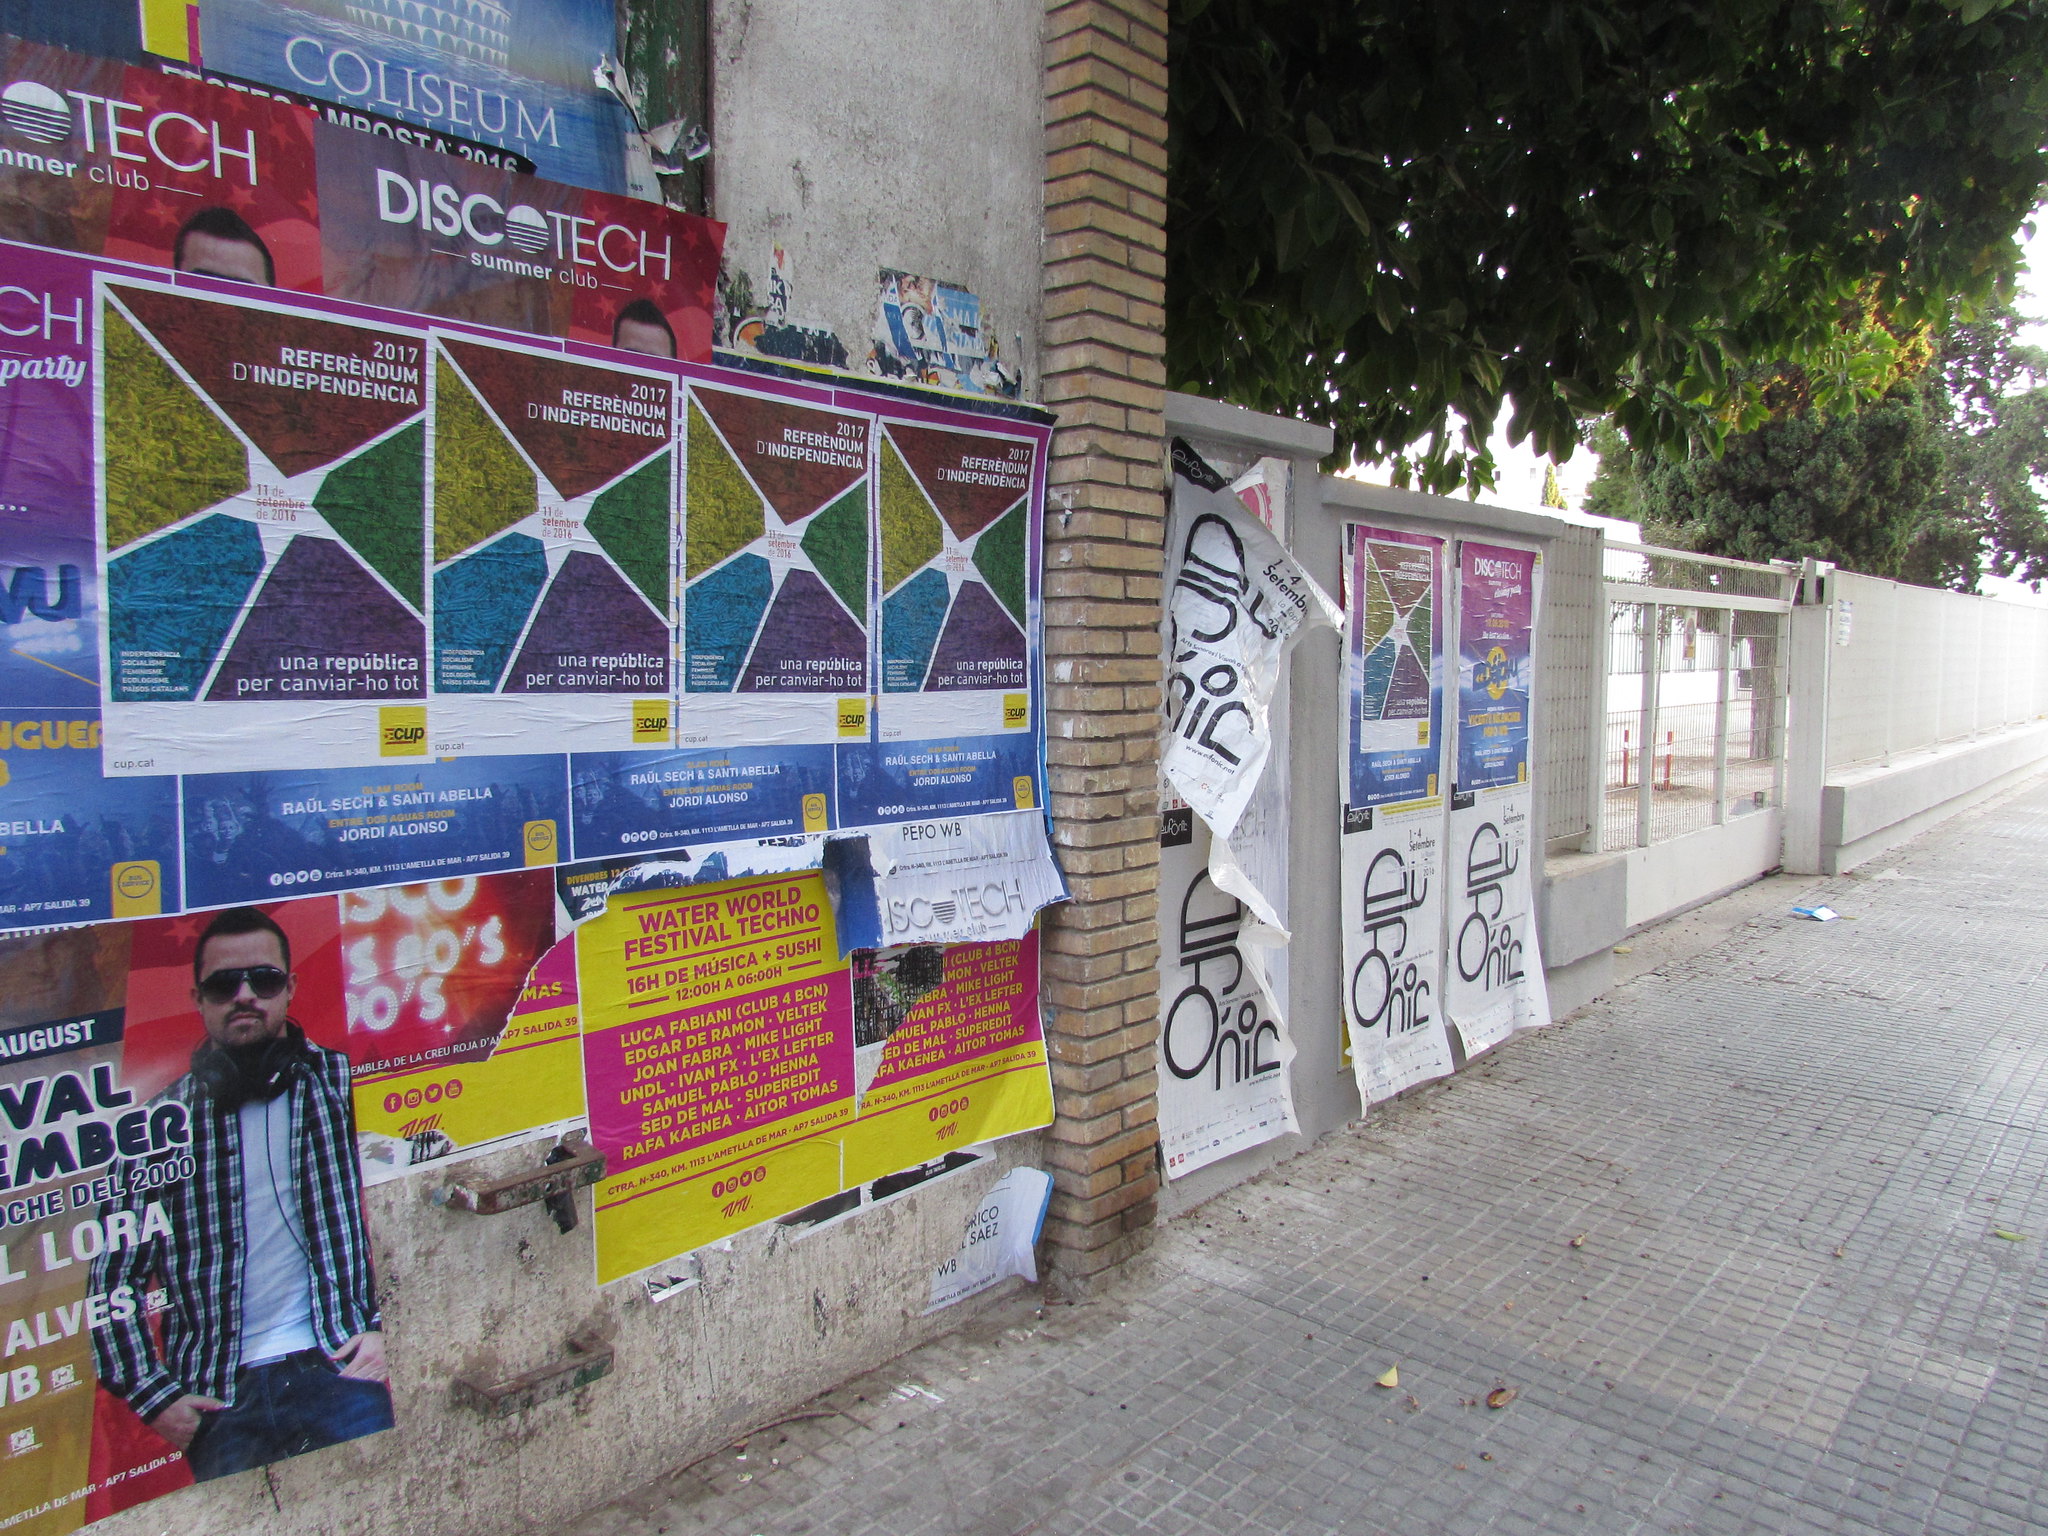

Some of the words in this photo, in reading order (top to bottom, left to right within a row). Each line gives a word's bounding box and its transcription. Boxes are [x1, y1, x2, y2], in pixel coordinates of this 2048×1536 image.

[286, 37, 561, 148] COLISEUM
[89, 164, 150, 191] club
[471, 251, 552, 280] summer
[559, 268, 598, 289] club
[373, 341, 419, 364] 2017
[281, 347, 419, 385] REFERÈNDUM
[233, 362, 419, 405] D'INDEPENDÈNCIA
[631, 383, 666, 403] 2017
[563, 390, 666, 421] REFERÈNDUM
[528, 402, 666, 439] D'INDEPENDÈNCIA
[837, 422, 865, 439] 2017
[783, 428, 864, 455] REFERÈNDUM
[757, 441, 864, 470] D'INDEPENDÈNCIA
[961, 456, 1028, 475] REFERÈNDUM
[1008, 448, 1030, 462] 2017
[256, 497, 305, 509] setembre
[542, 517, 578, 528] setembre
[280, 657, 318, 671] una
[325, 653, 419, 675] república
[558, 656, 587, 668] una
[592, 652, 664, 672] república
[780, 659, 802, 670] una
[806, 656, 862, 674] república
[957, 659, 974, 670] una
[977, 658, 1023, 674] república
[237, 676, 271, 696] per
[280, 674, 390, 692] canviar-ho
[395, 674, 419, 691] tot
[526, 673, 552, 689] per
[558, 671, 640, 687] canviar-ho
[646, 671, 664, 686] tot
[756, 675, 777, 689] per
[781, 672, 843, 686] canviar-ho
[847, 673, 862, 687] tot
[938, 675, 956, 687] per
[957, 673, 1008, 686] canviar-ho
[434, 742, 464, 752] cup.cat
[685, 734, 708, 744] cup.cat
[113, 758, 155, 770] cup.cat
[665, 770, 694, 782] SECH
[708, 767, 738, 779] SANTI
[741, 765, 780, 776] ABELLA
[913, 776, 939, 786] JORDI
[333, 795, 374, 811] SECH
[392, 791, 435, 806] SANTI
[439, 787, 493, 802] ABELLA
[670, 797, 702, 808] JORDI
[706, 792, 748, 805] ALONSO
[339, 826, 385, 842] JORDI
[389, 821, 448, 837] ALONSO
[902, 824, 936, 841] PEPO
[940, 822, 962, 837] WB
[567, 870, 608, 885] DIVENDRES
[638, 902, 720, 934] WATER
[726, 886, 802, 916] WORLD
[624, 923, 732, 960] FESTIVAL
[737, 904, 820, 930] TECHNO
[627, 974, 659, 994] 16H
[666, 968, 689, 987] DE
[694, 956, 758, 980] MÚSICA
[776, 938, 822, 960] SUSHI
[981, 955, 1019, 973] VELTEK
[676, 982, 720, 1001] 12:00H
[737, 966, 782, 987] 06:00H
[957, 980, 982, 994] MIKE
[985, 971, 1015, 987] LIGHT
[985, 983, 1023, 1001] LEFTER
[621, 1027, 664, 1048] LUCA
[670, 1007, 732, 1036] FABIANI
[783, 993, 792, 1004] 4
[795, 983, 829, 1002] BCN)
[931, 1014, 966, 1031] PABLO
[974, 1000, 1011, 1018] HENNA
[956, 1015, 1012, 1039] SUPEREDIT
[523, 1021, 563, 1037] SALIDA
[624, 1039, 682, 1066] EDGAR
[686, 1033, 706, 1050] DE
[711, 1017, 766, 1043] RAMON
[776, 1000, 828, 1024] VELTEK
[425, 1047, 451, 1061] CREU
[453, 1041, 478, 1055] ROJA
[633, 1061, 678, 1082] JOAN
[682, 1047, 733, 1070] FABRA
[745, 1032, 779, 1051] MIKE
[783, 1018, 823, 1040] LIGHT
[899, 1049, 946, 1071] KAENEA
[620, 1084, 666, 1105] UNDL
[678, 1069, 716, 1088] IVAN
[719, 1062, 739, 1078] FX
[750, 1047, 780, 1067] L'EX
[784, 1031, 834, 1057] LEFTER
[642, 1090, 706, 1117] SAMUEL
[711, 1070, 758, 1094] PABLO
[770, 1053, 819, 1078] HENNA
[641, 1117, 672, 1136] SED
[677, 1110, 698, 1127] DE
[702, 1099, 734, 1118] MAL
[745, 1068, 822, 1103] SUPEREDIT
[622, 1138, 666, 1161] RAFA
[670, 1116, 732, 1144] KAENEA
[744, 1098, 788, 1122] AITOR
[792, 1080, 838, 1104] TOMAS
[608, 1180, 636, 1196] CTRA.
[639, 1170, 670, 1187] N-340,
[707, 1140, 754, 1162] L'AMETLLA
[810, 1112, 838, 1128] SALIDA
[71, 1174, 127, 1211] DEL
[131, 1155, 197, 1193] 2000
[42, 1201, 175, 1272] LORA
[969, 1222, 999, 1246] SAEZ
[938, 1258, 957, 1277] WB
[4, 1284, 138, 1358] ALVES
[70, 1485, 96, 1501] MAR
[105, 1472, 127, 1488] AP7
[128, 1457, 167, 1479] SALIDA
